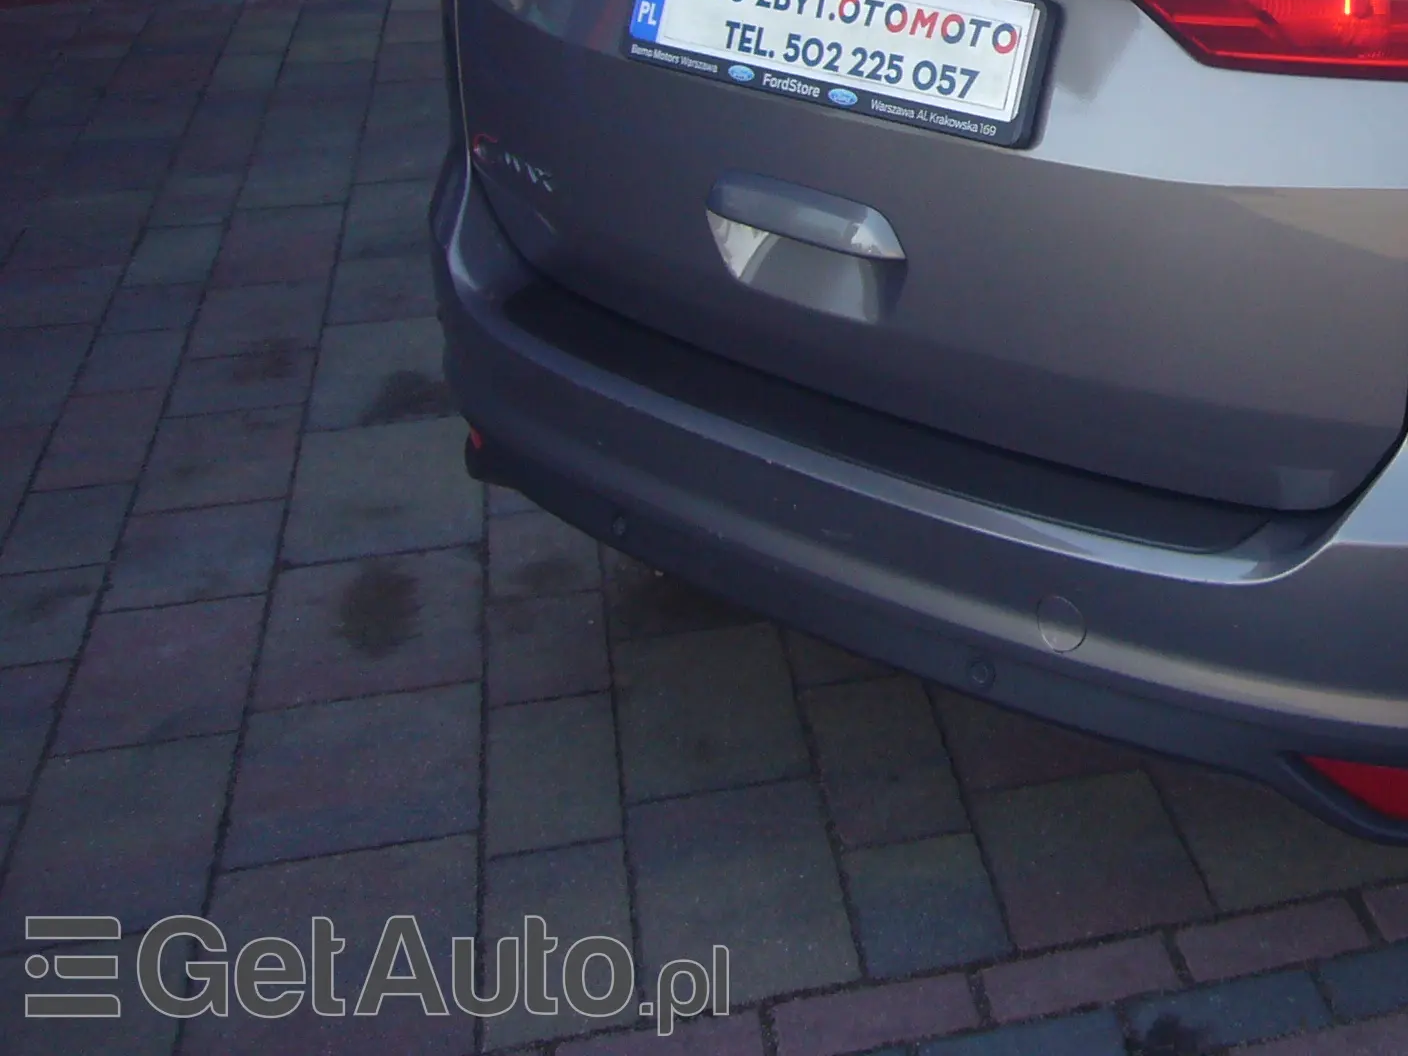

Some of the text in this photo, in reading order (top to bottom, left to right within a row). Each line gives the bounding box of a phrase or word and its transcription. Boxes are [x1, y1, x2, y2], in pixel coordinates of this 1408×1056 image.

[637, 0, 657, 26] PL
[653, 48, 680, 64] Motors
[725, 20, 980, 99] TEL. 502 225 057
[762, 73, 820, 98] FordStore
[870, 98, 915, 119] Warszawa
[929, 110, 978, 133] Krakowska
[979, 122, 997, 137] 169
